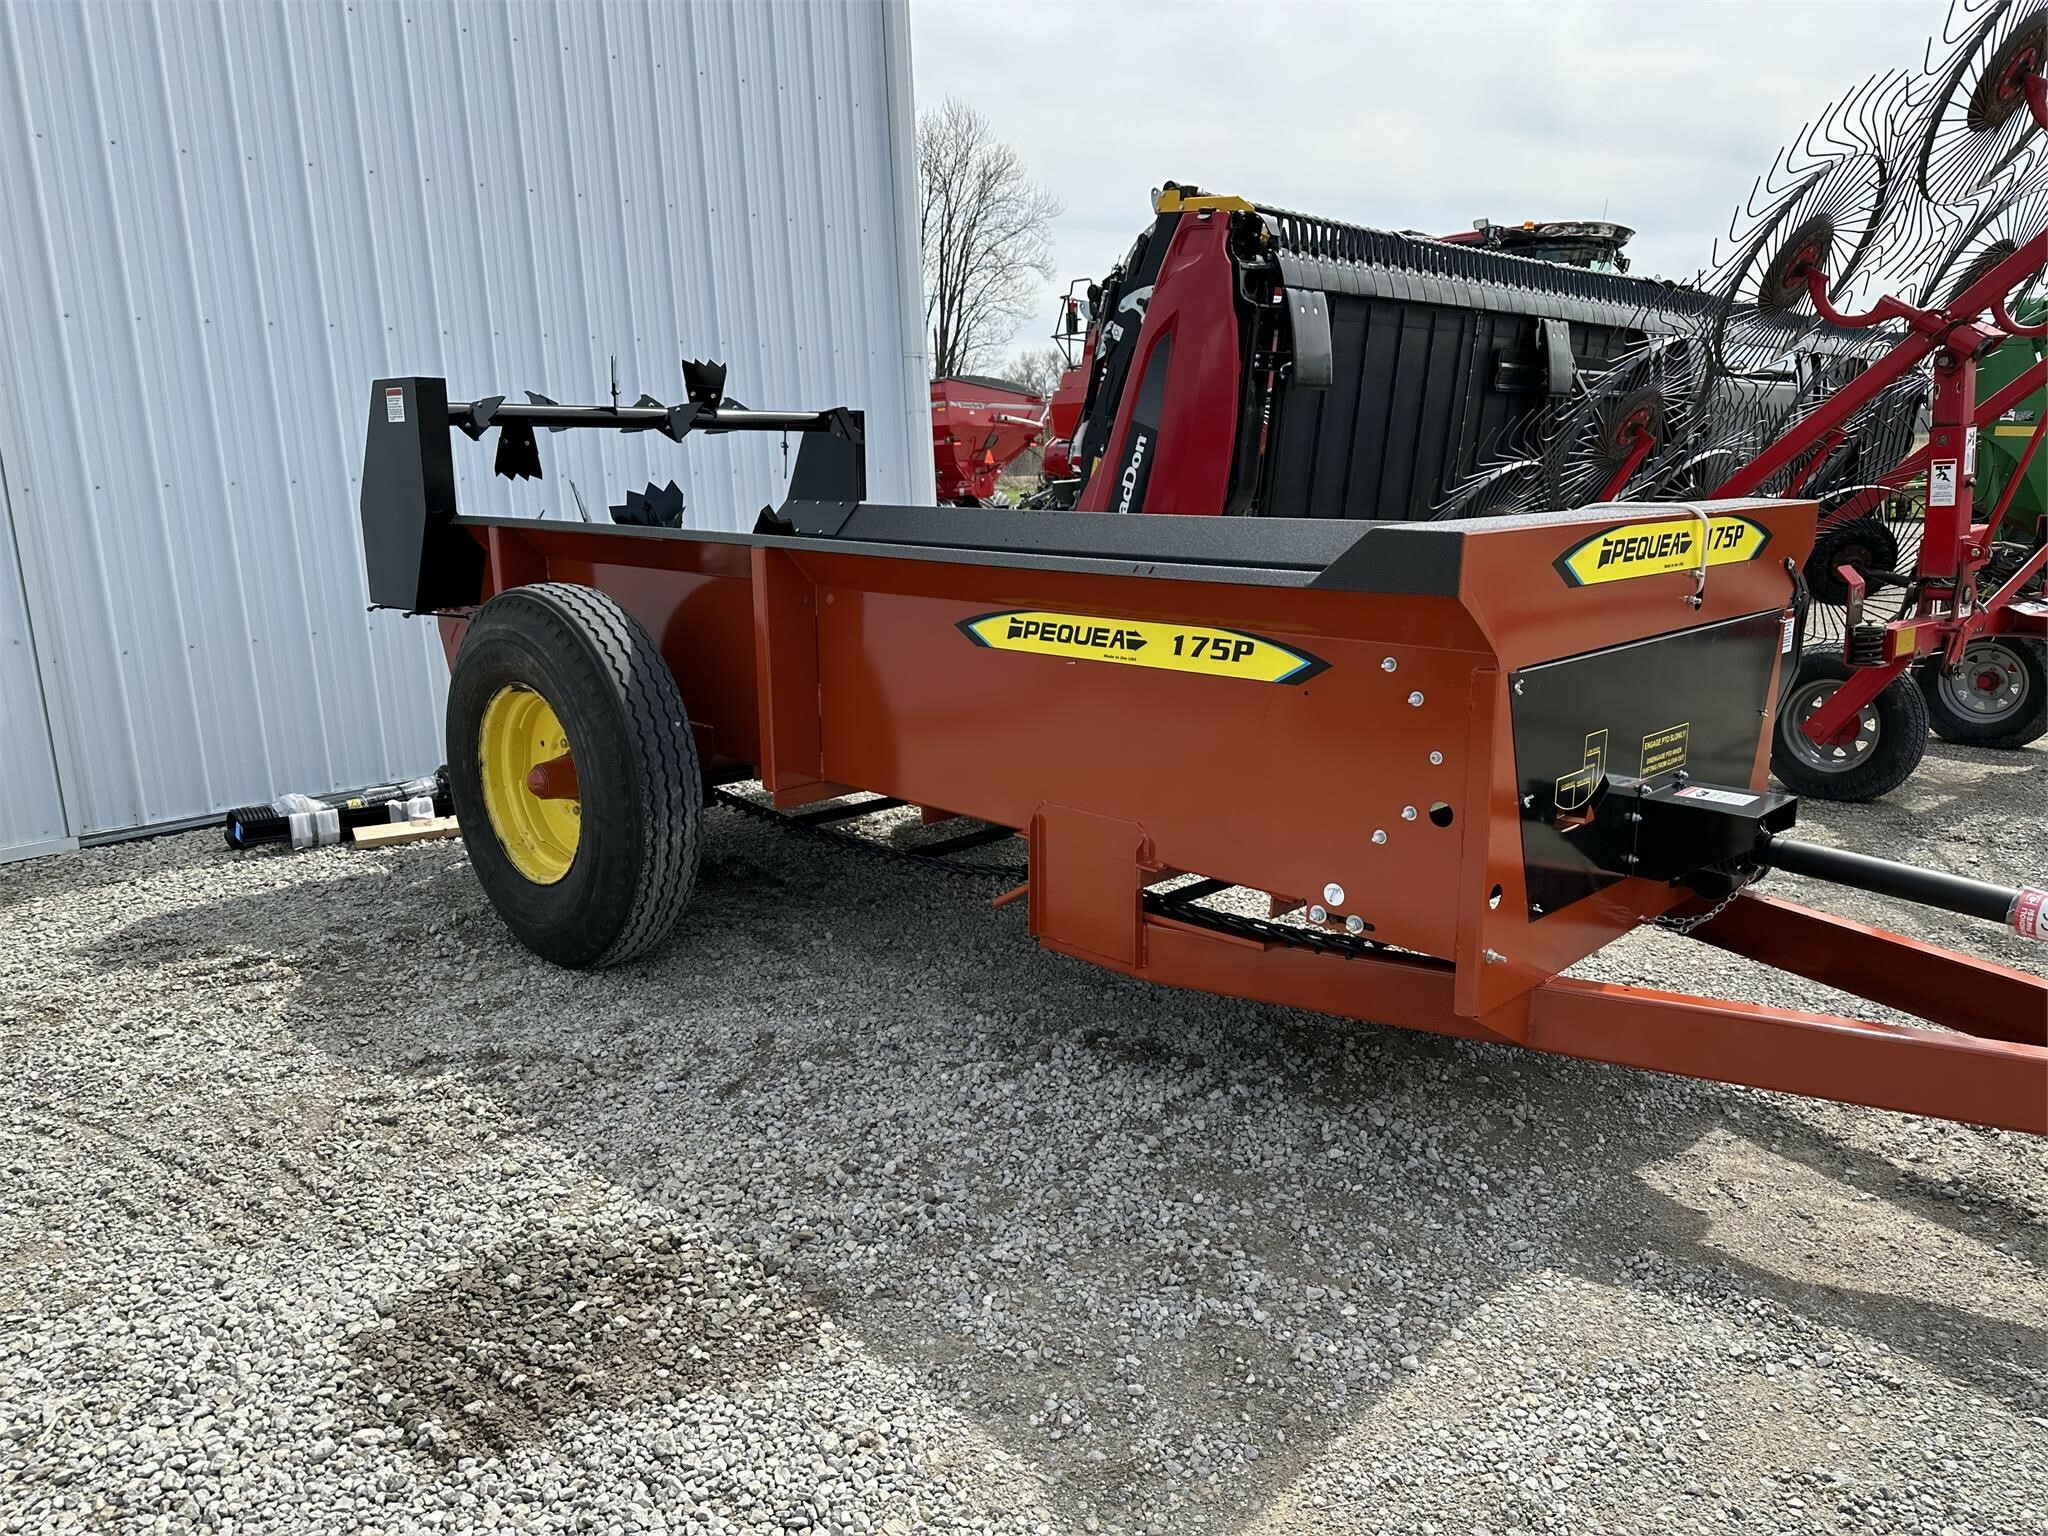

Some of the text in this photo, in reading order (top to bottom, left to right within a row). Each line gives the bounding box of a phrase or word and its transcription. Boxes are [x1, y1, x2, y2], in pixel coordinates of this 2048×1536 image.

[1119, 435, 1147, 514] acDon
[1610, 532, 1681, 565] PEQUEA
[1023, 620, 1255, 663] PEQUEA 175P
